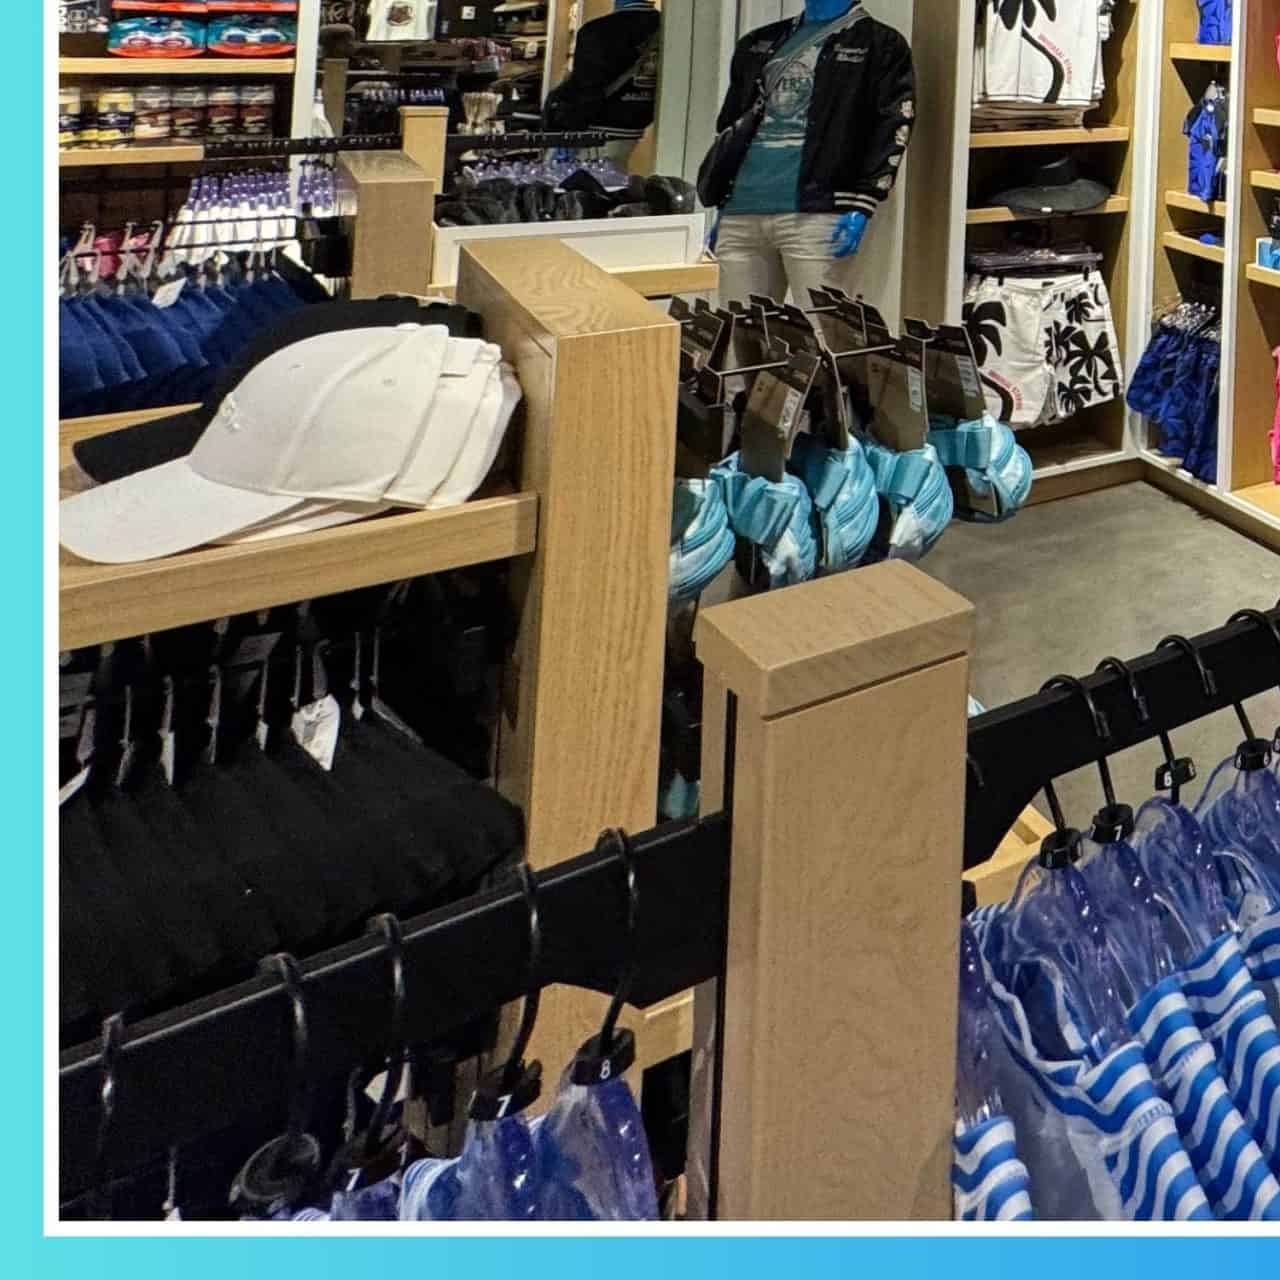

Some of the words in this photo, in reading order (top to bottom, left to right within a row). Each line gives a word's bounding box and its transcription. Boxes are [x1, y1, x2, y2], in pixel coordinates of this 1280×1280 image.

[1164, 770, 1172, 787] 6
[1113, 824, 1123, 841] 7
[600, 1059, 611, 1080] 8
[497, 1093, 513, 1118] 7
[345, 1167, 361, 1192] 7
